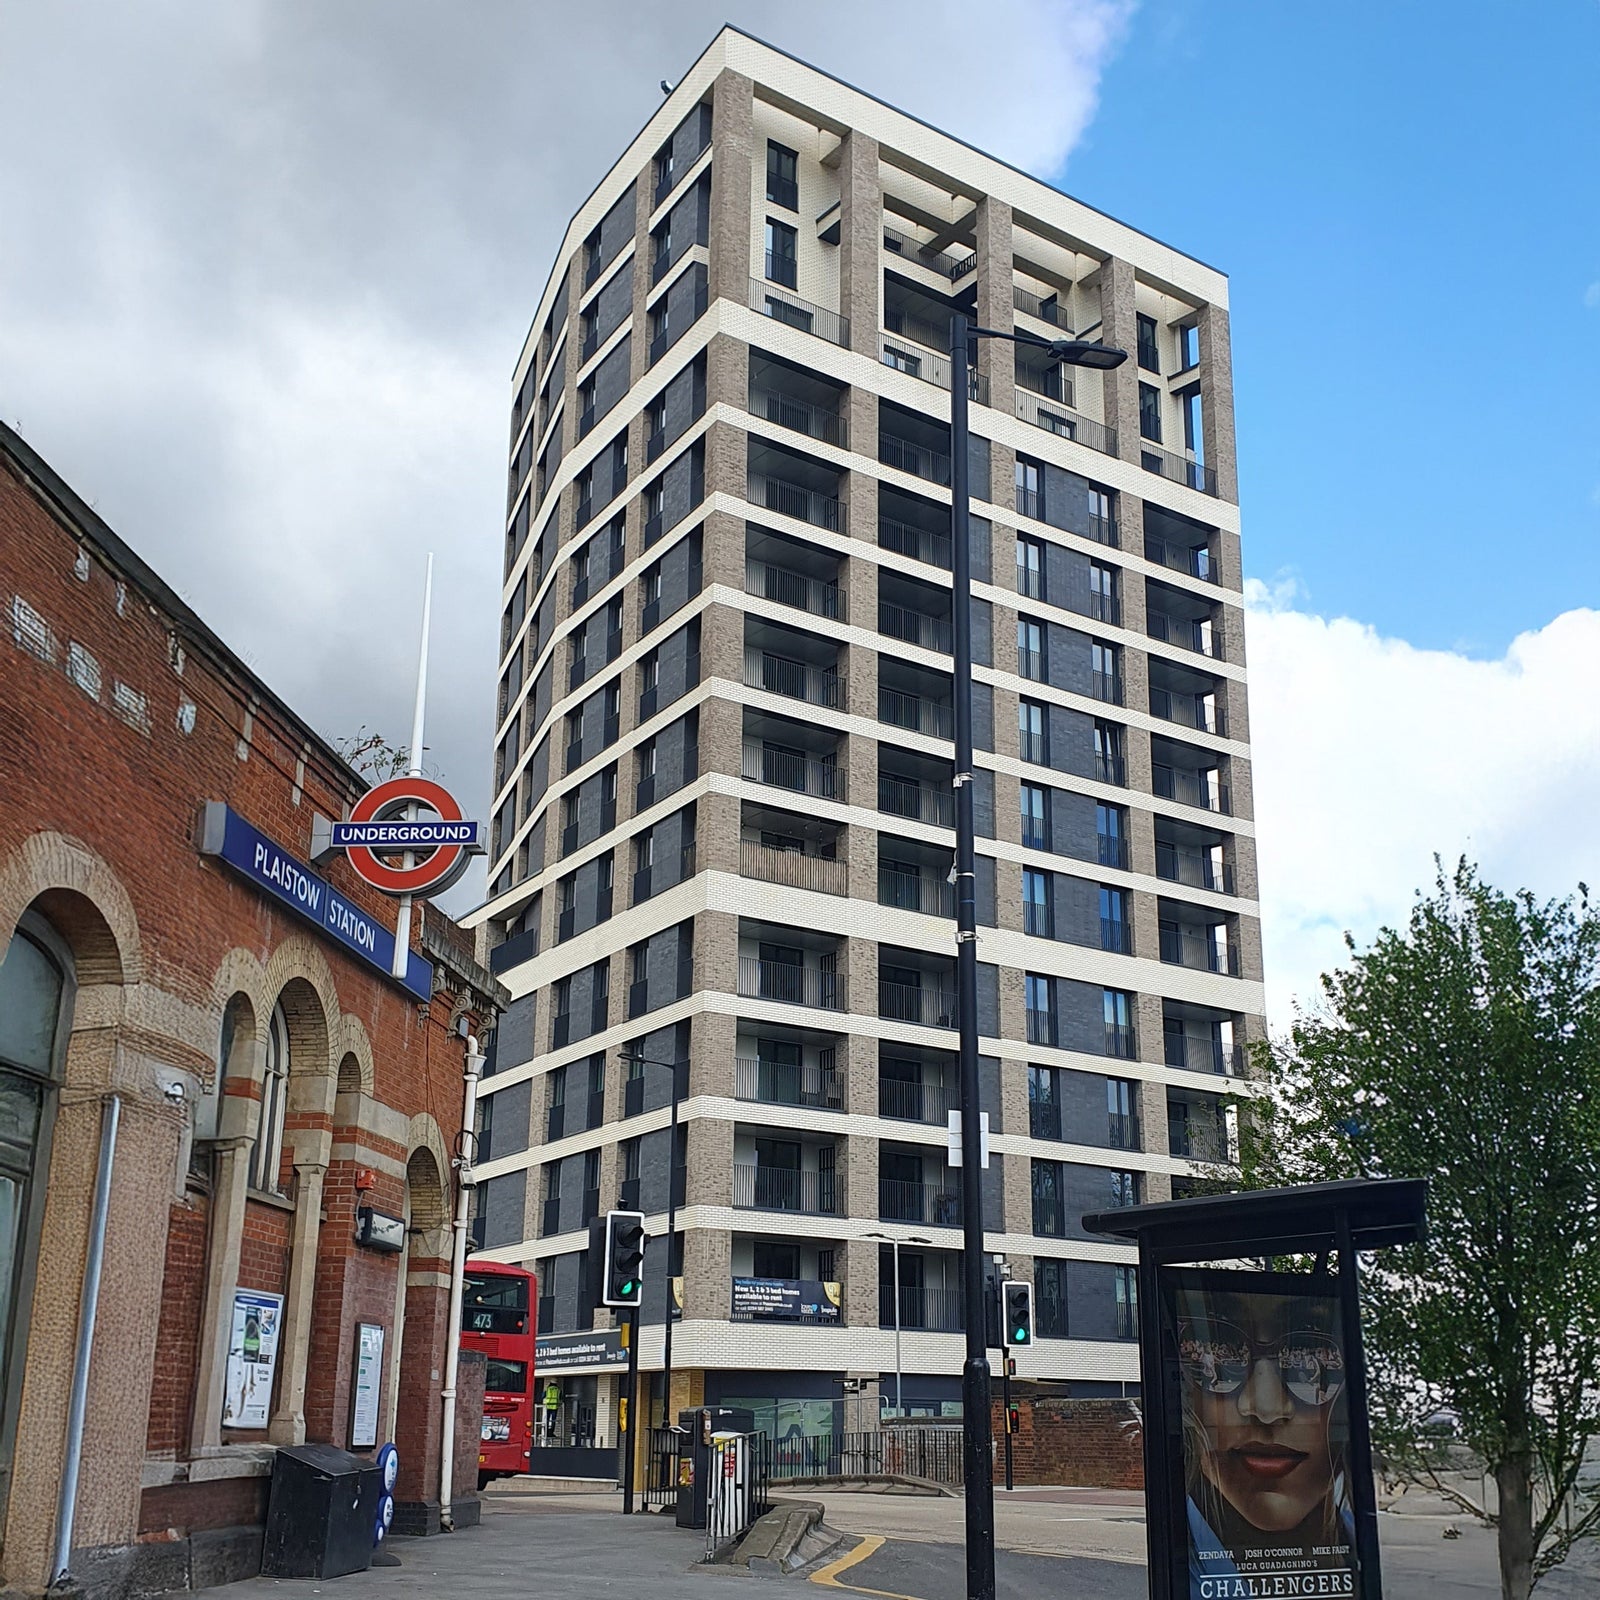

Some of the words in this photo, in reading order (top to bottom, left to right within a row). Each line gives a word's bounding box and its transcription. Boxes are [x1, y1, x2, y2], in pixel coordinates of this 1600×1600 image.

[341, 826, 471, 841] UNDERGROUND
[254, 842, 320, 911] PLAISTOW
[329, 899, 375, 953] STATION
[473, 1313, 492, 1329] 473
[1198, 1550, 1235, 1560] ZENDAYA
[1244, 1549, 1263, 1560] JOSH
[1264, 1547, 1303, 1558] O'CONNOR
[1312, 1546, 1331, 1555] MIKE
[1332, 1545, 1350, 1554] FAIST
[1236, 1562, 1258, 1571] LUCA
[1259, 1559, 1318, 1570] GUADAGNINO'S
[1200, 1574, 1353, 1599] CHALLENGERS
